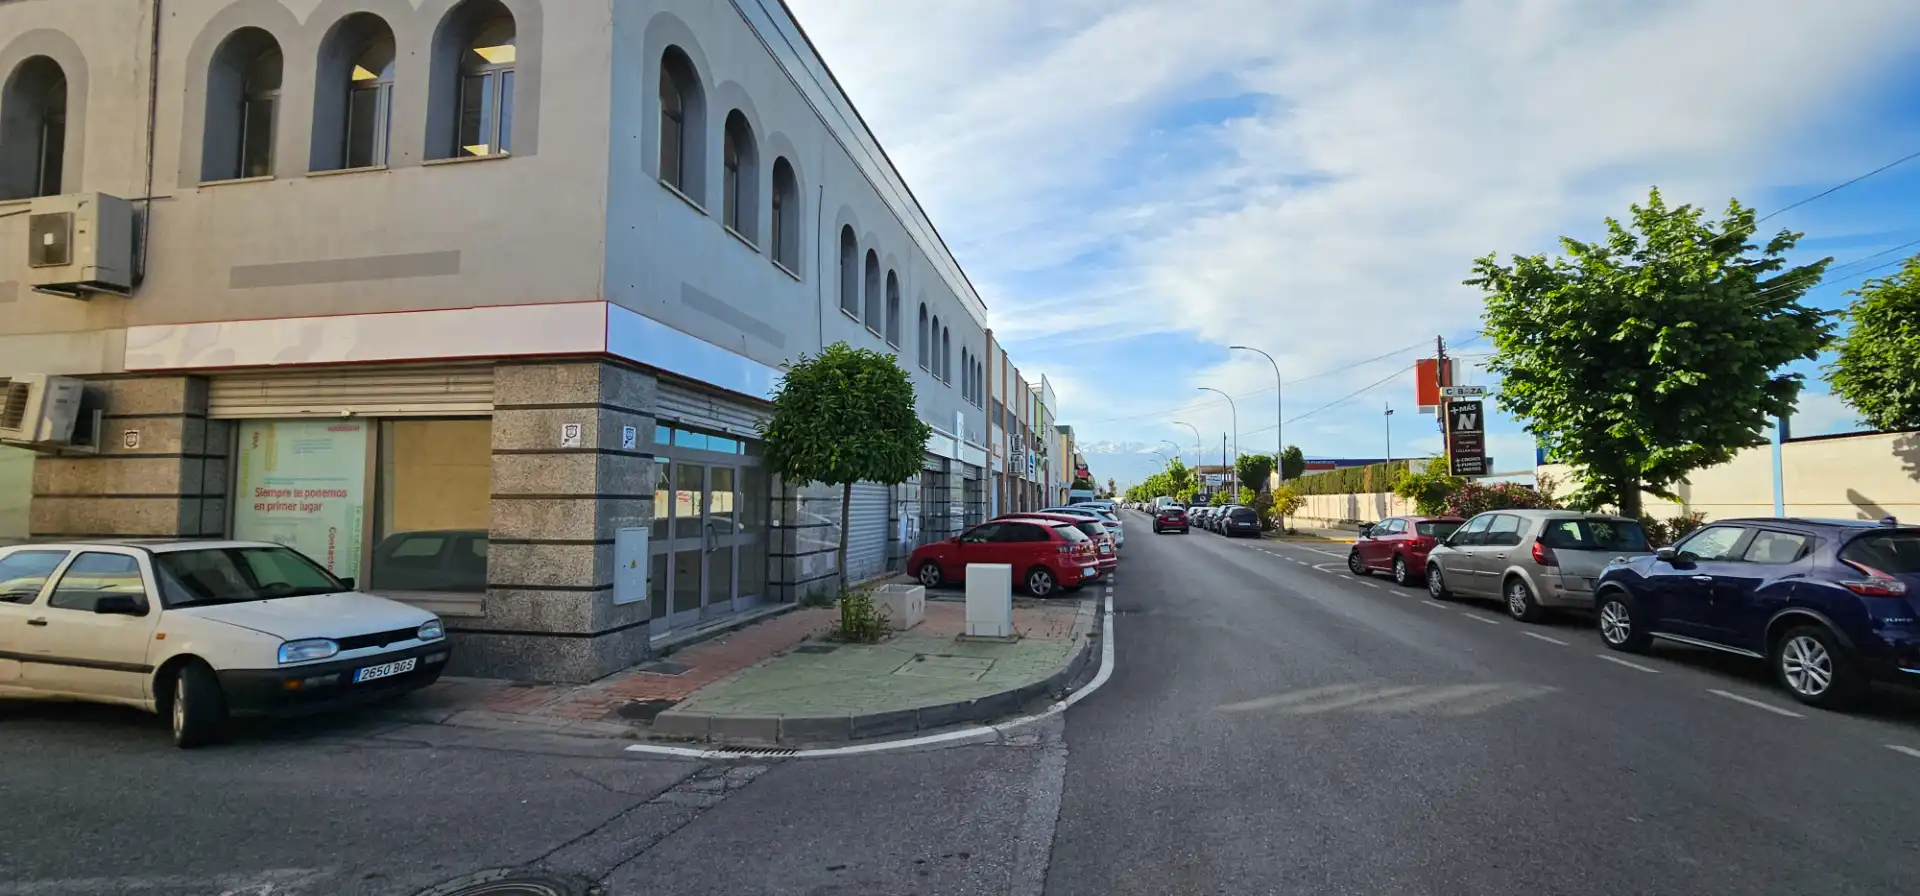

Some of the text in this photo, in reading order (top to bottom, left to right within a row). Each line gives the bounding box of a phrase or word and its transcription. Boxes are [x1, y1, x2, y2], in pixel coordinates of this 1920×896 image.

[1457, 413, 1476, 430] N
[254, 487, 347, 500] Siempre te ponemos
[254, 500, 323, 513] en primer lugar
[361, 660, 412, 679] 2650 BGS
